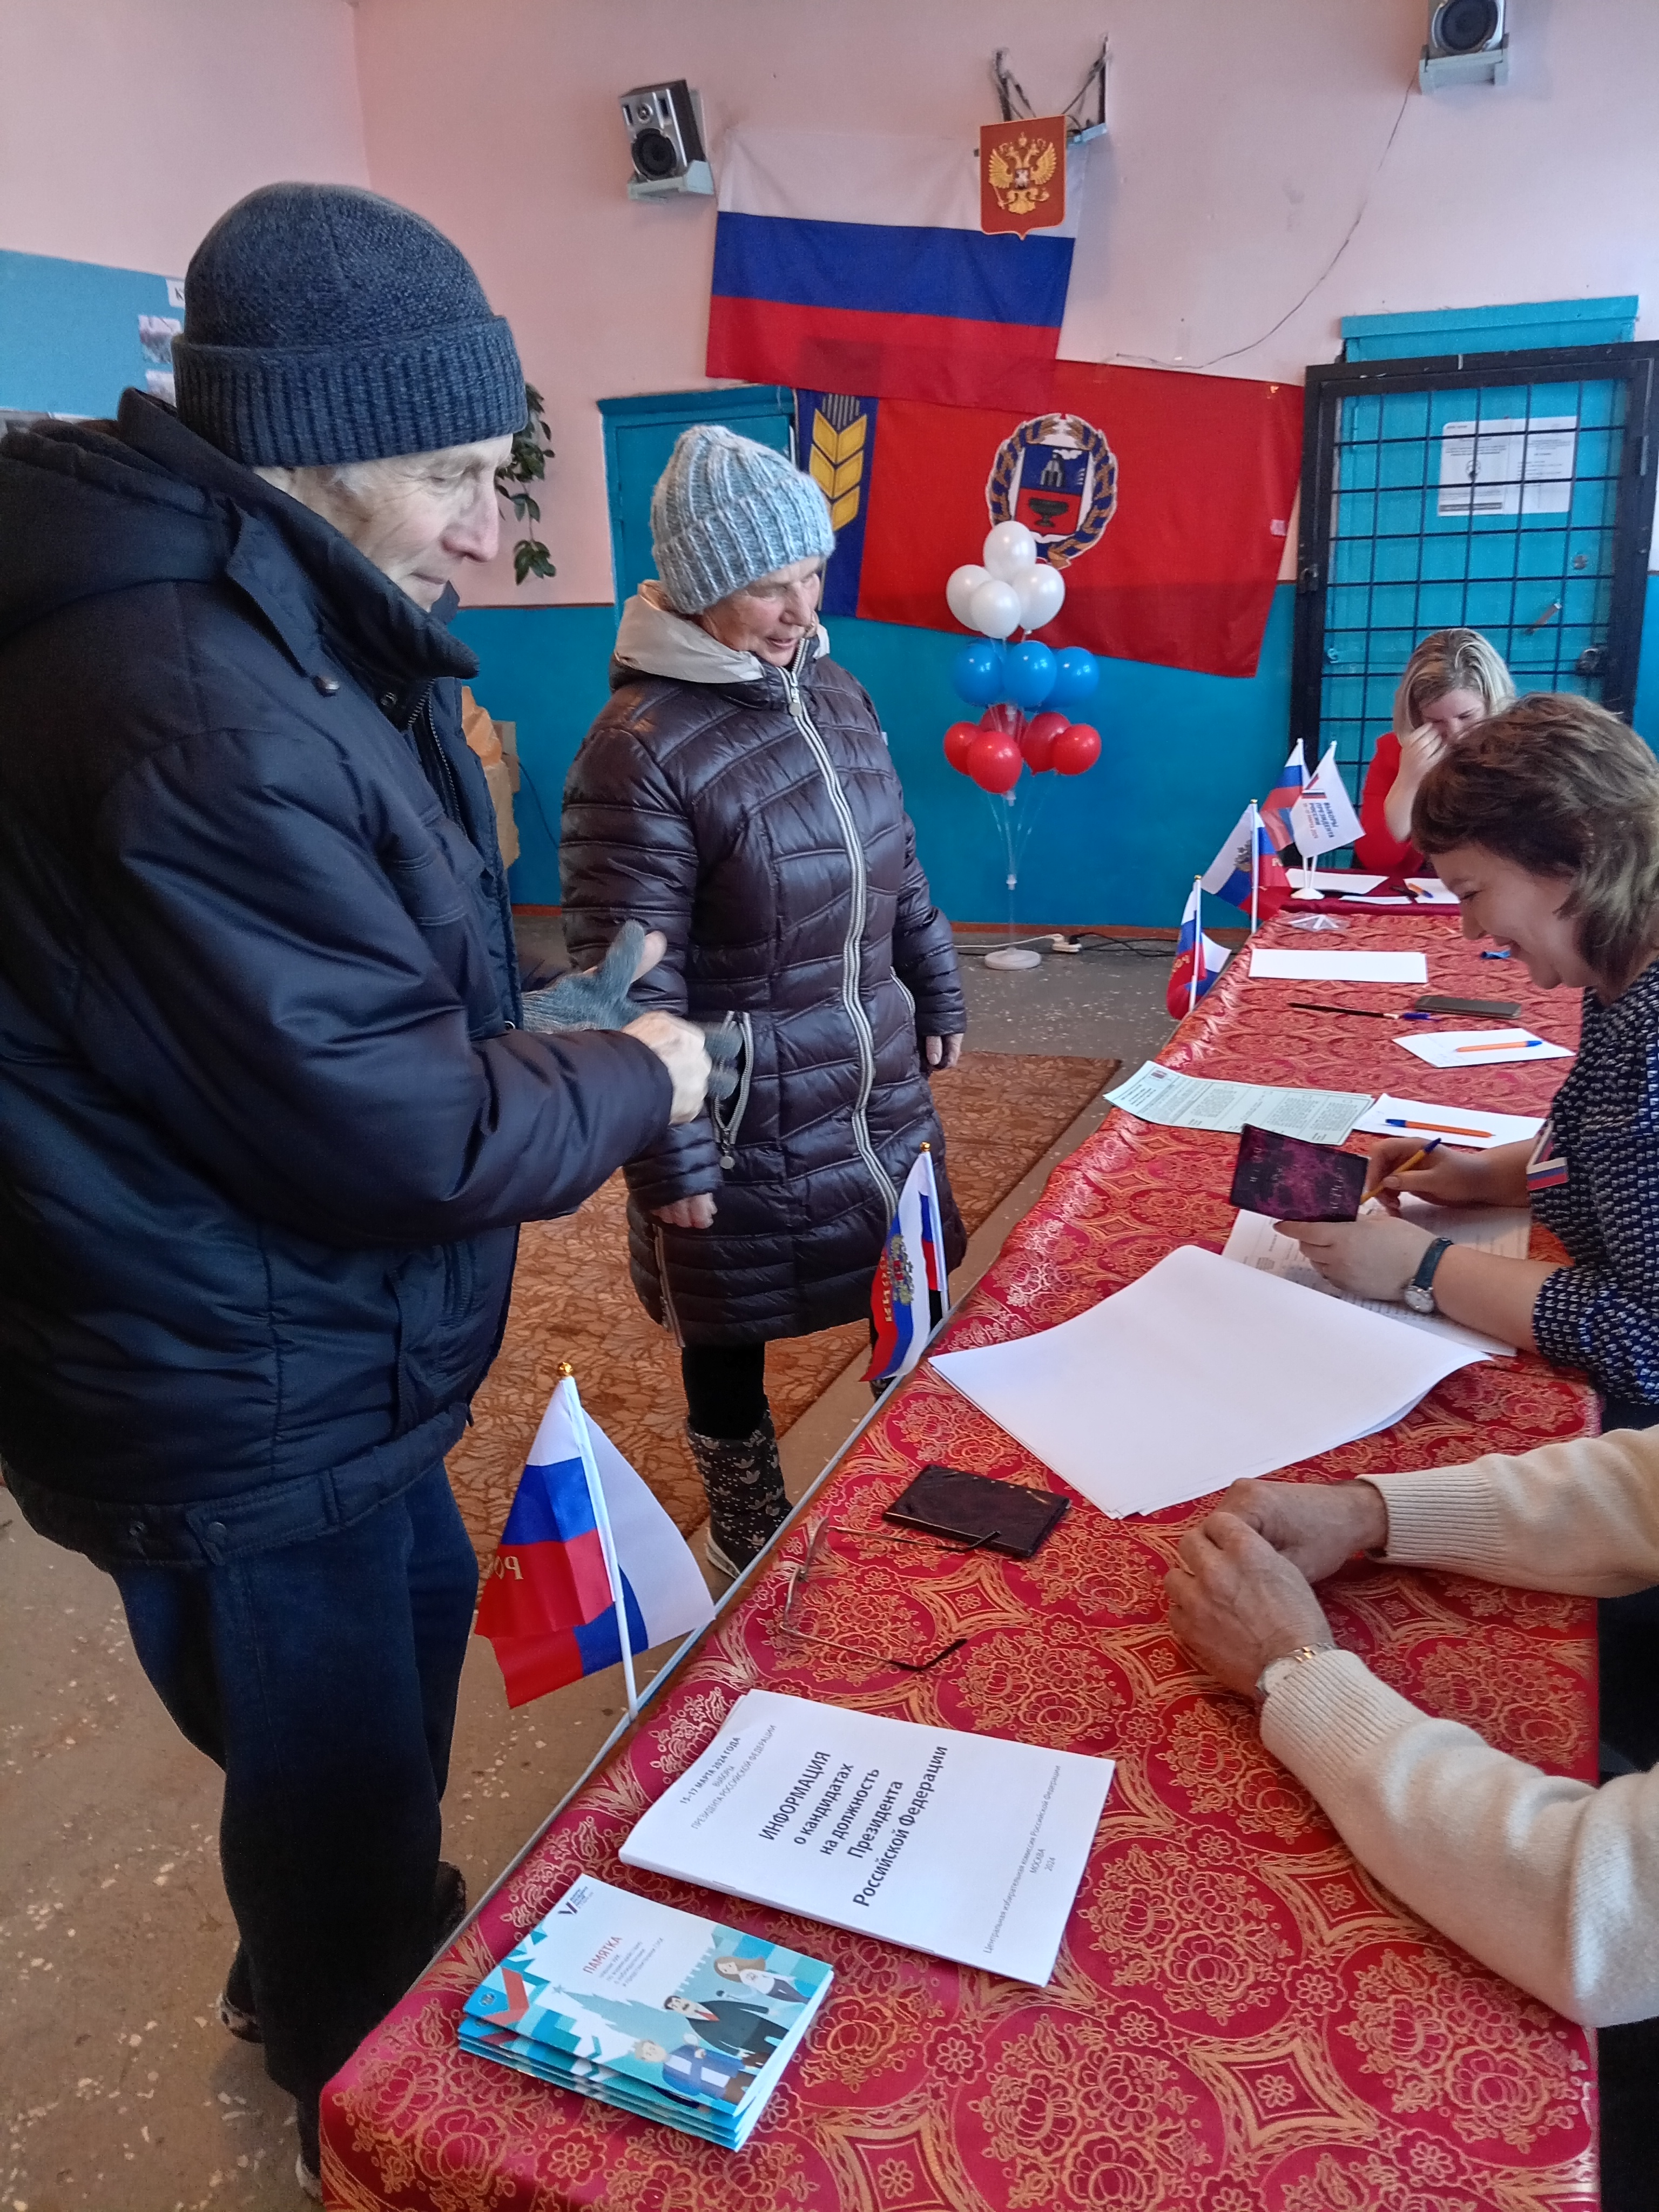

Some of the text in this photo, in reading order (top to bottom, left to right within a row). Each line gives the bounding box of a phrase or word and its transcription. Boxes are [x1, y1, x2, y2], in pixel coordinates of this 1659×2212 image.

[691, 1724, 778, 1830] ПРЕЗИДЕНТА РОССИЙСКОЙ ФЕДЕРАЦИИ
[694, 1769, 716, 1789] МАРТА
[712, 1755, 728, 1770] 2024
[723, 1737, 741, 1755] ГОДА
[712, 1765, 736, 1788] ВЫБОРЫ
[758, 1751, 831, 1840] ИНФОРМАЦИЯ
[794, 1763, 854, 1845] о кандидатах
[819, 1769, 880, 1855] на должность
[847, 1781, 903, 1858] Президента
[853, 1746, 948, 1907] Российской Федерации
[983, 1765, 1061, 1954] Центральная избирательная комиссия Российской Федерации
[1029, 1849, 1046, 1873] МОСКВА
[1044, 1857, 1056, 1871] 2024
[582, 1936, 623, 1974] ПАМЯТКА
